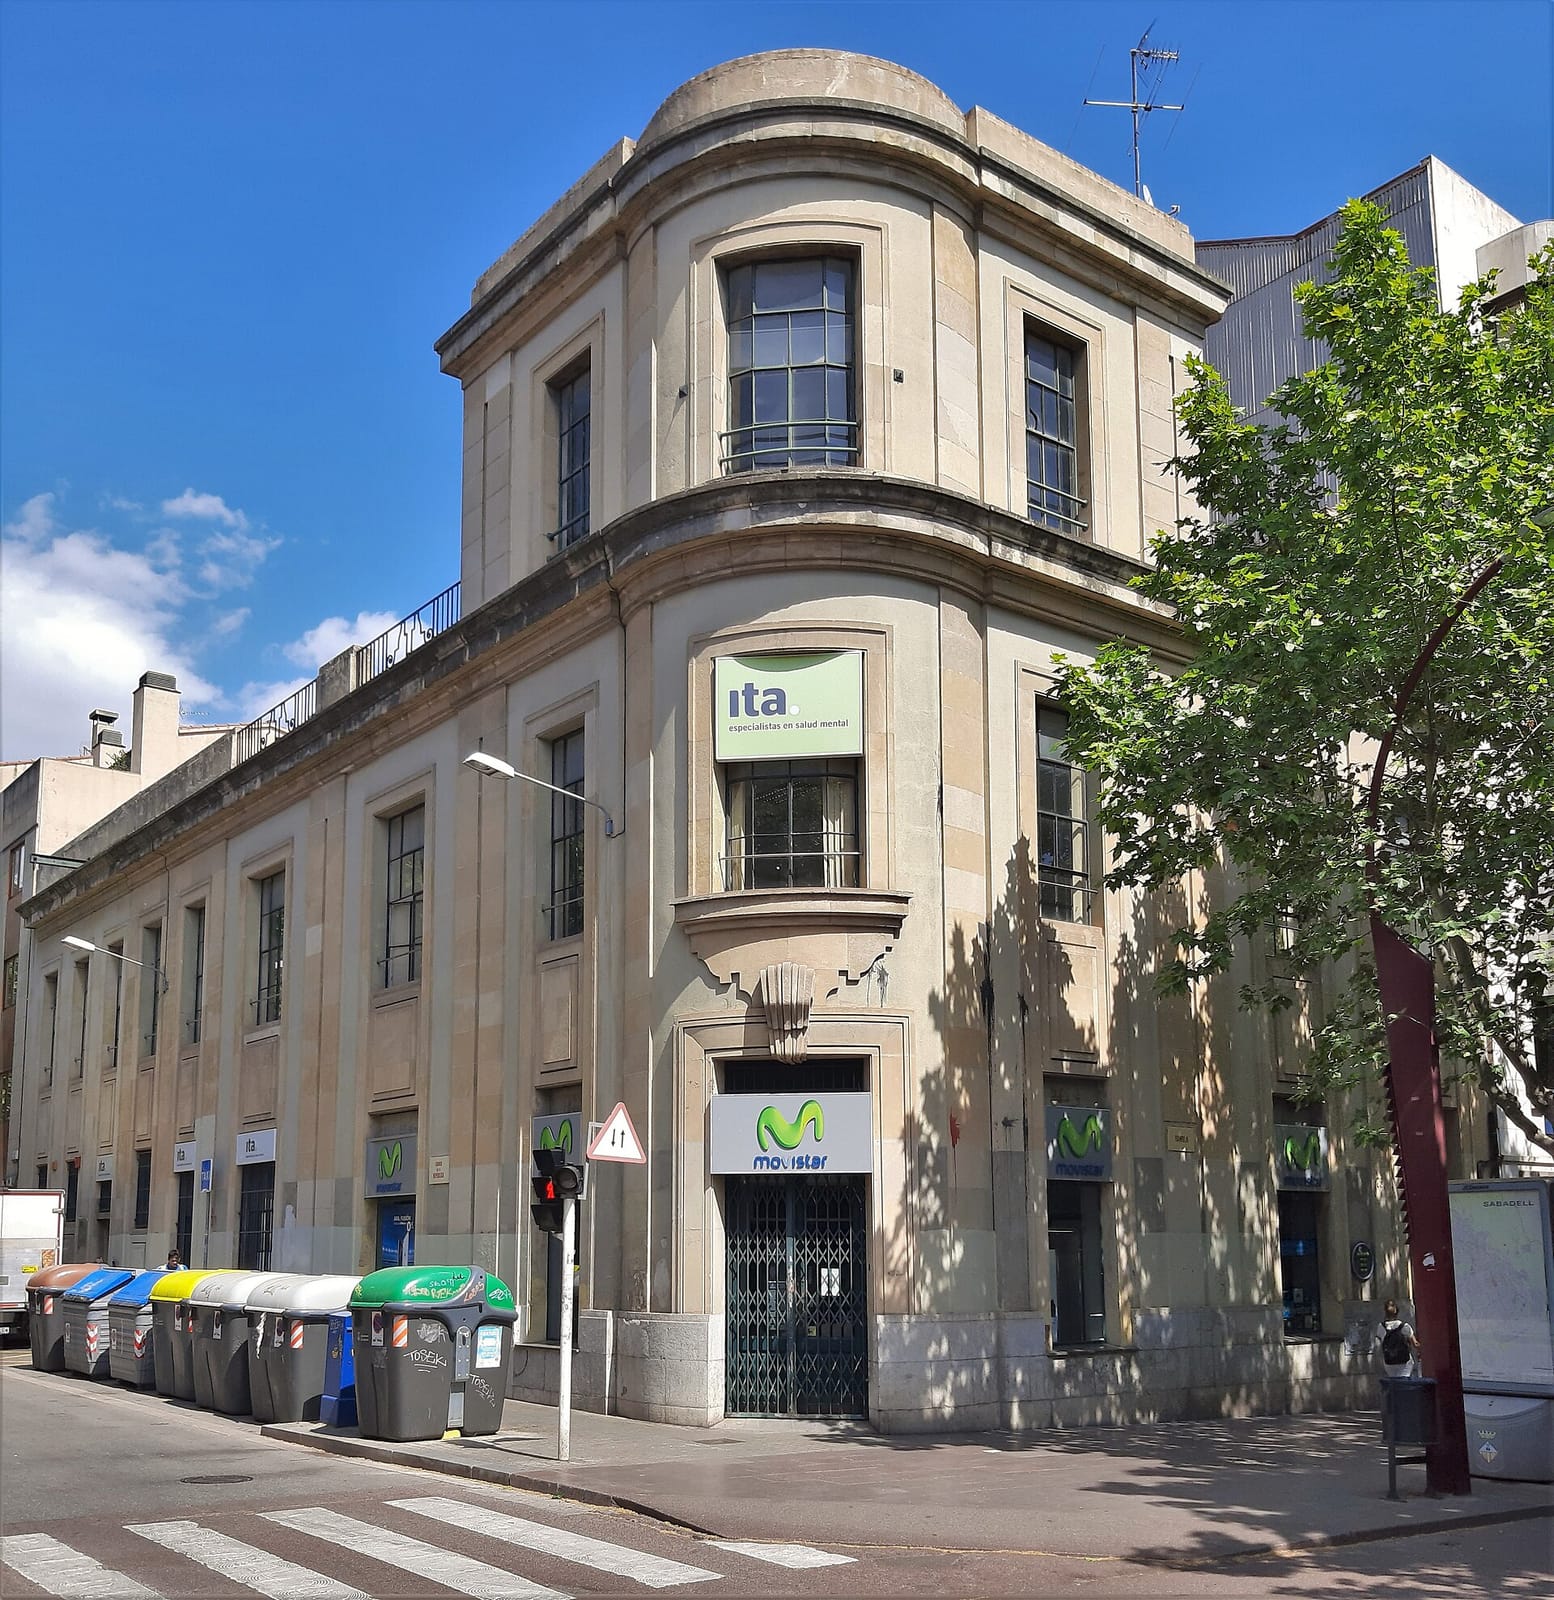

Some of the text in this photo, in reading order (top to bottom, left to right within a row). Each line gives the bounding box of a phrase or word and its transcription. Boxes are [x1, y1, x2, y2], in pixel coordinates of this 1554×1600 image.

[728, 719, 849, 733] especialistas en salud mental
[753, 1154, 828, 1170] movistar
[1482, 1200, 1535, 1208] SABADELL
